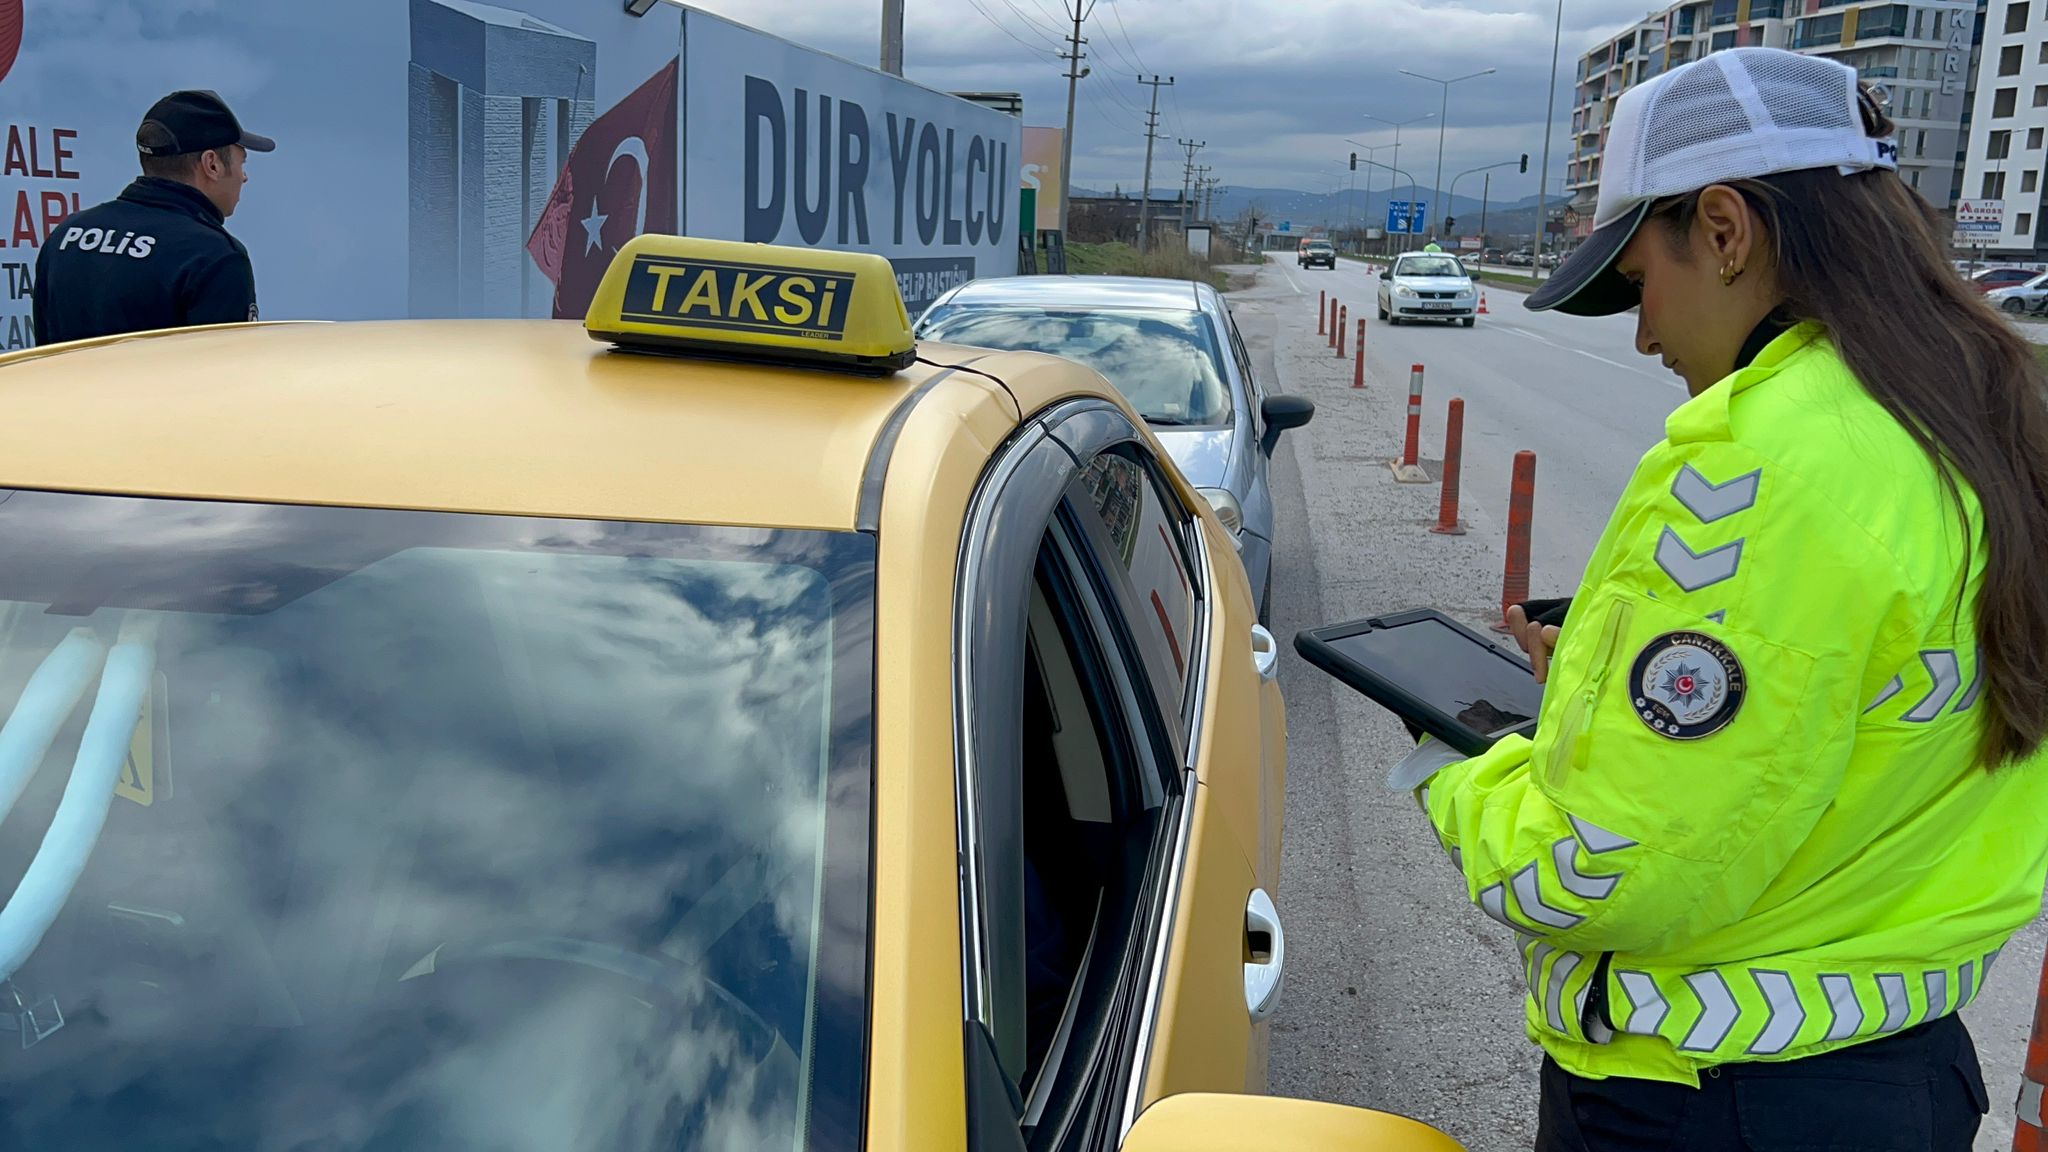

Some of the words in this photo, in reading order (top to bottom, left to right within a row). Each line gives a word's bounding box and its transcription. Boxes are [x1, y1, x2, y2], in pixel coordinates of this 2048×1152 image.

[1942, 9, 1967, 95] KARE
[0, 125, 80, 179] ALE
[744, 75, 869, 245] DUR
[886, 112, 1007, 246] YOLCU
